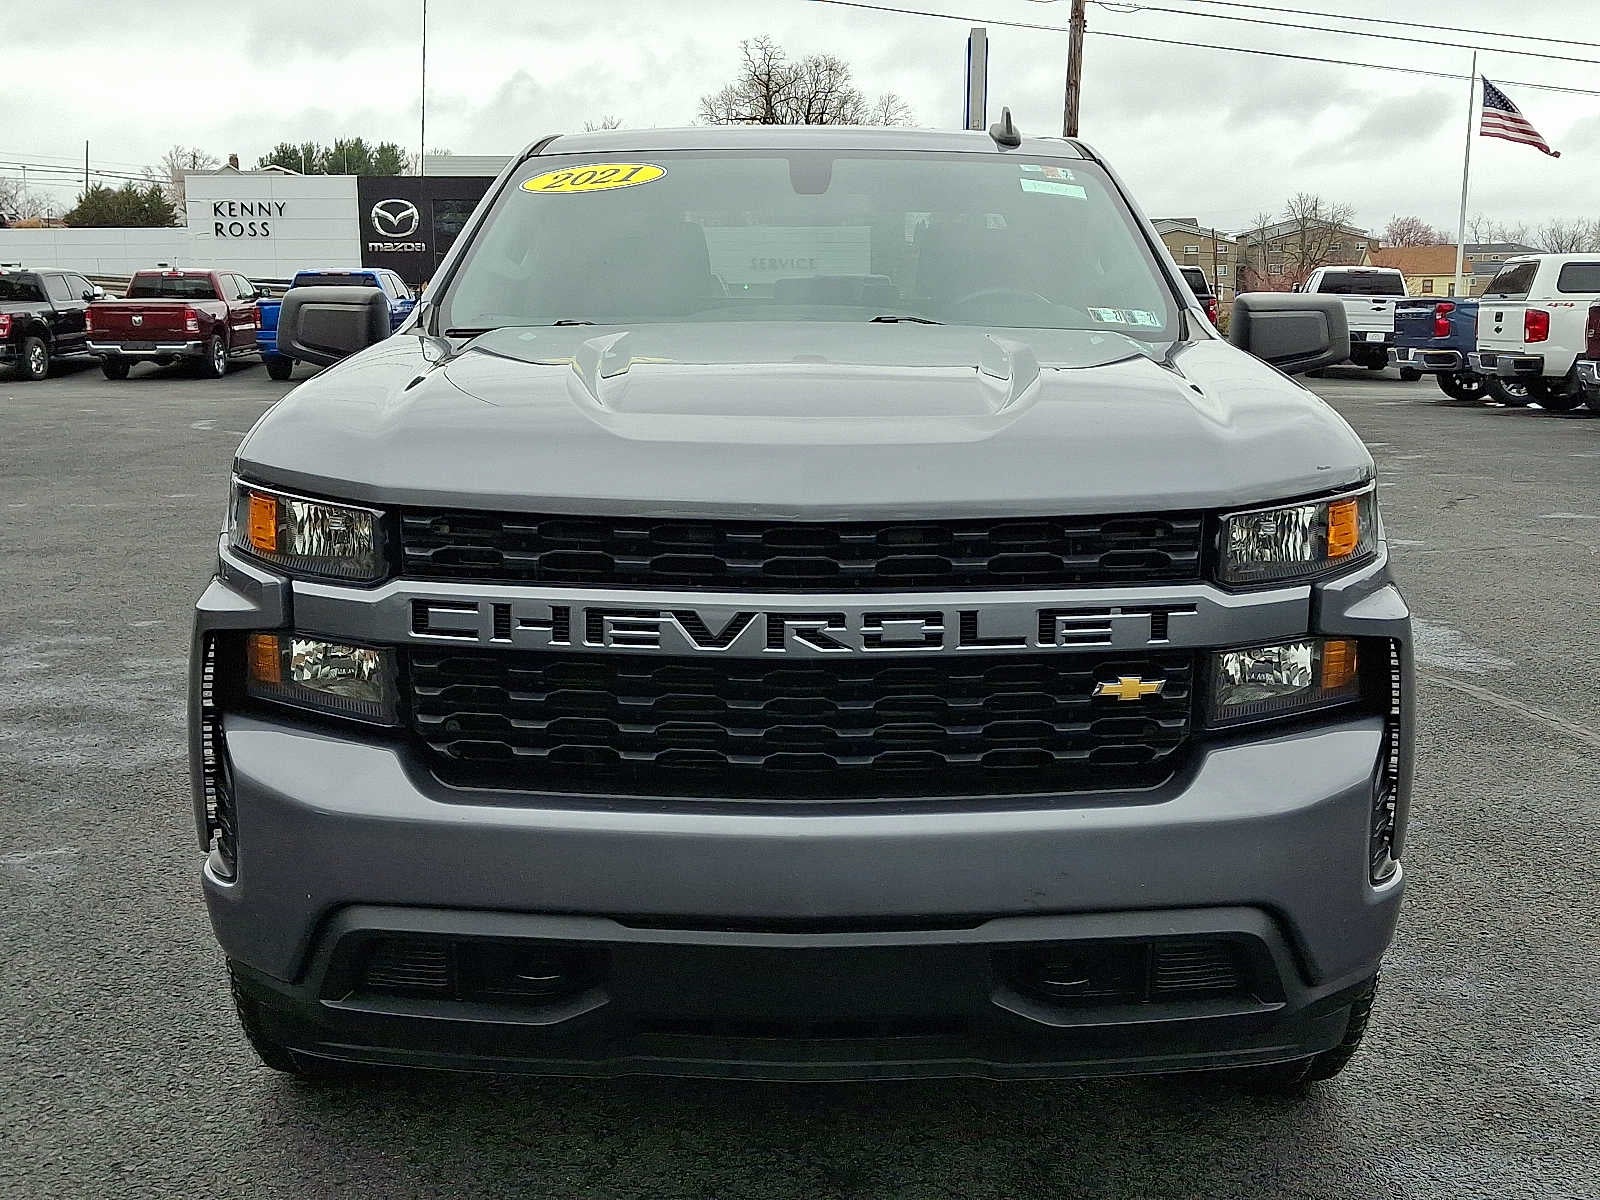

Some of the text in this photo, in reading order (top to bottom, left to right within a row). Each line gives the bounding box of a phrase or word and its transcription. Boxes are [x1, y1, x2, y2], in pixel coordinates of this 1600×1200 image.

[542, 166, 643, 190] 2021
[213, 201, 286, 217] KENNY
[214, 221, 270, 237] ROSS
[750, 257, 817, 271] SERVICE
[409, 598, 1198, 652] CHEVROLET
